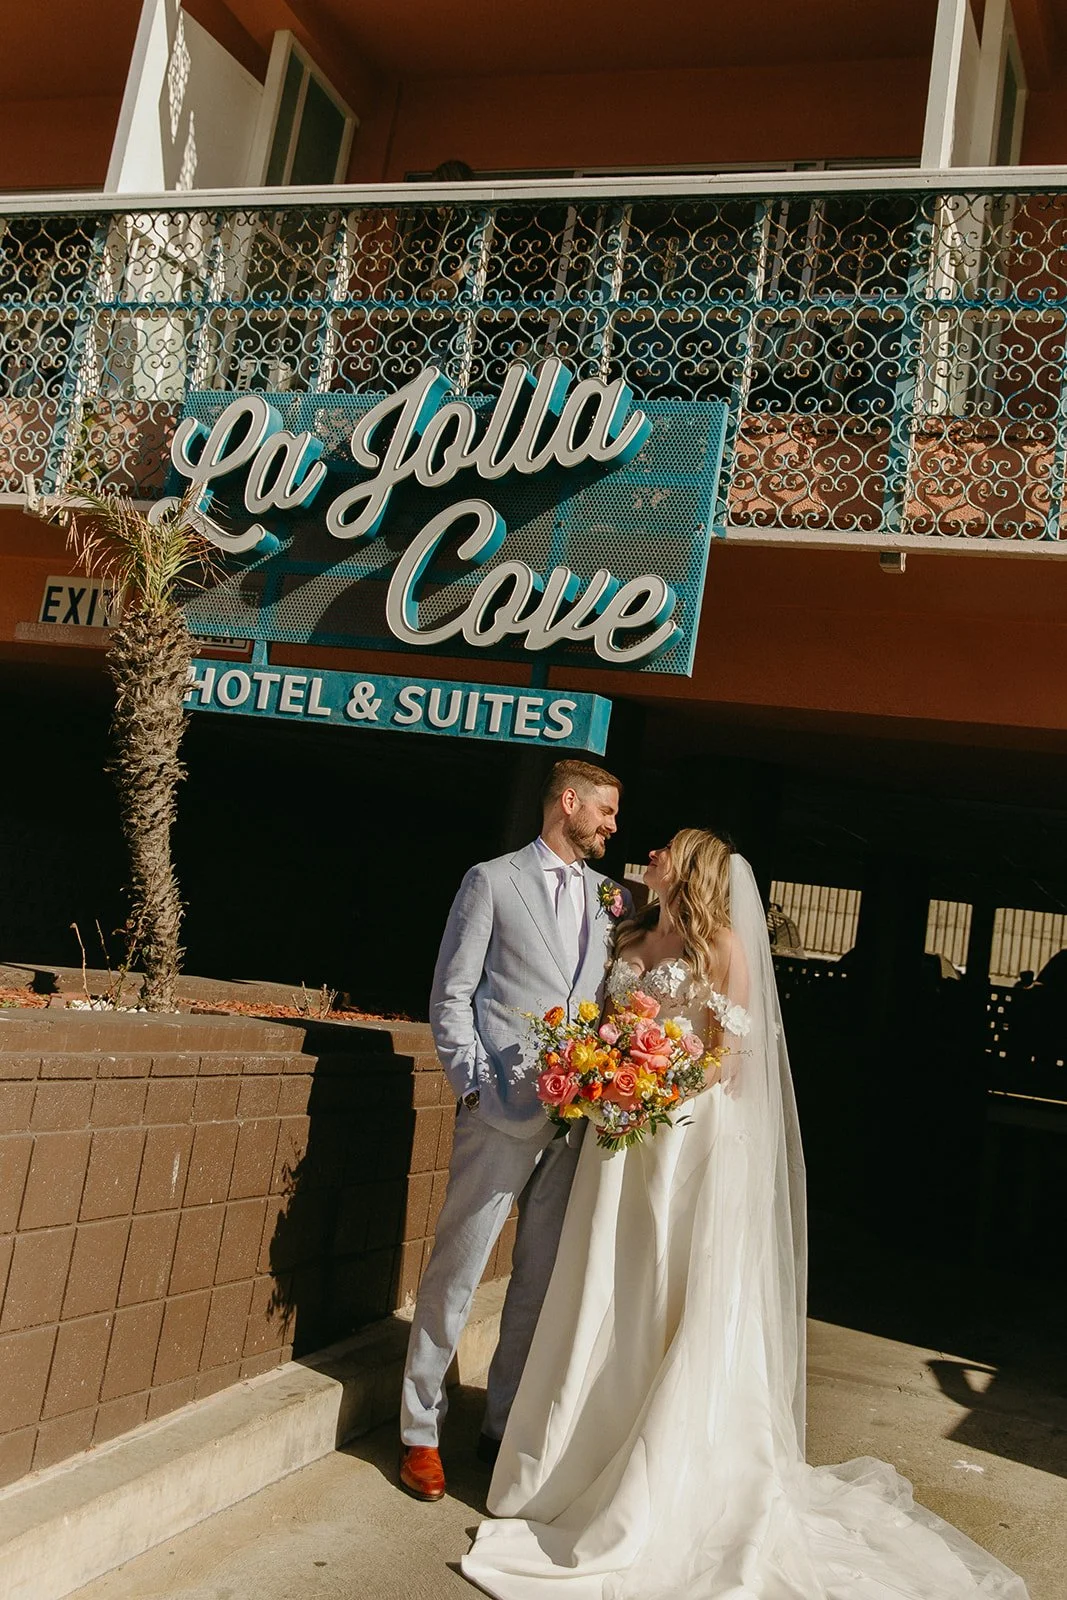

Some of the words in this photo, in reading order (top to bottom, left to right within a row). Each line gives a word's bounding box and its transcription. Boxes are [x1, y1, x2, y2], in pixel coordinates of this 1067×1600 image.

[148, 395, 328, 554] La
[326, 357, 648, 539] Jolla
[385, 498, 678, 663] Cove
[184, 666, 332, 717] HOTEL
[346, 681, 382, 721] &
[393, 685, 578, 740] SUITES
